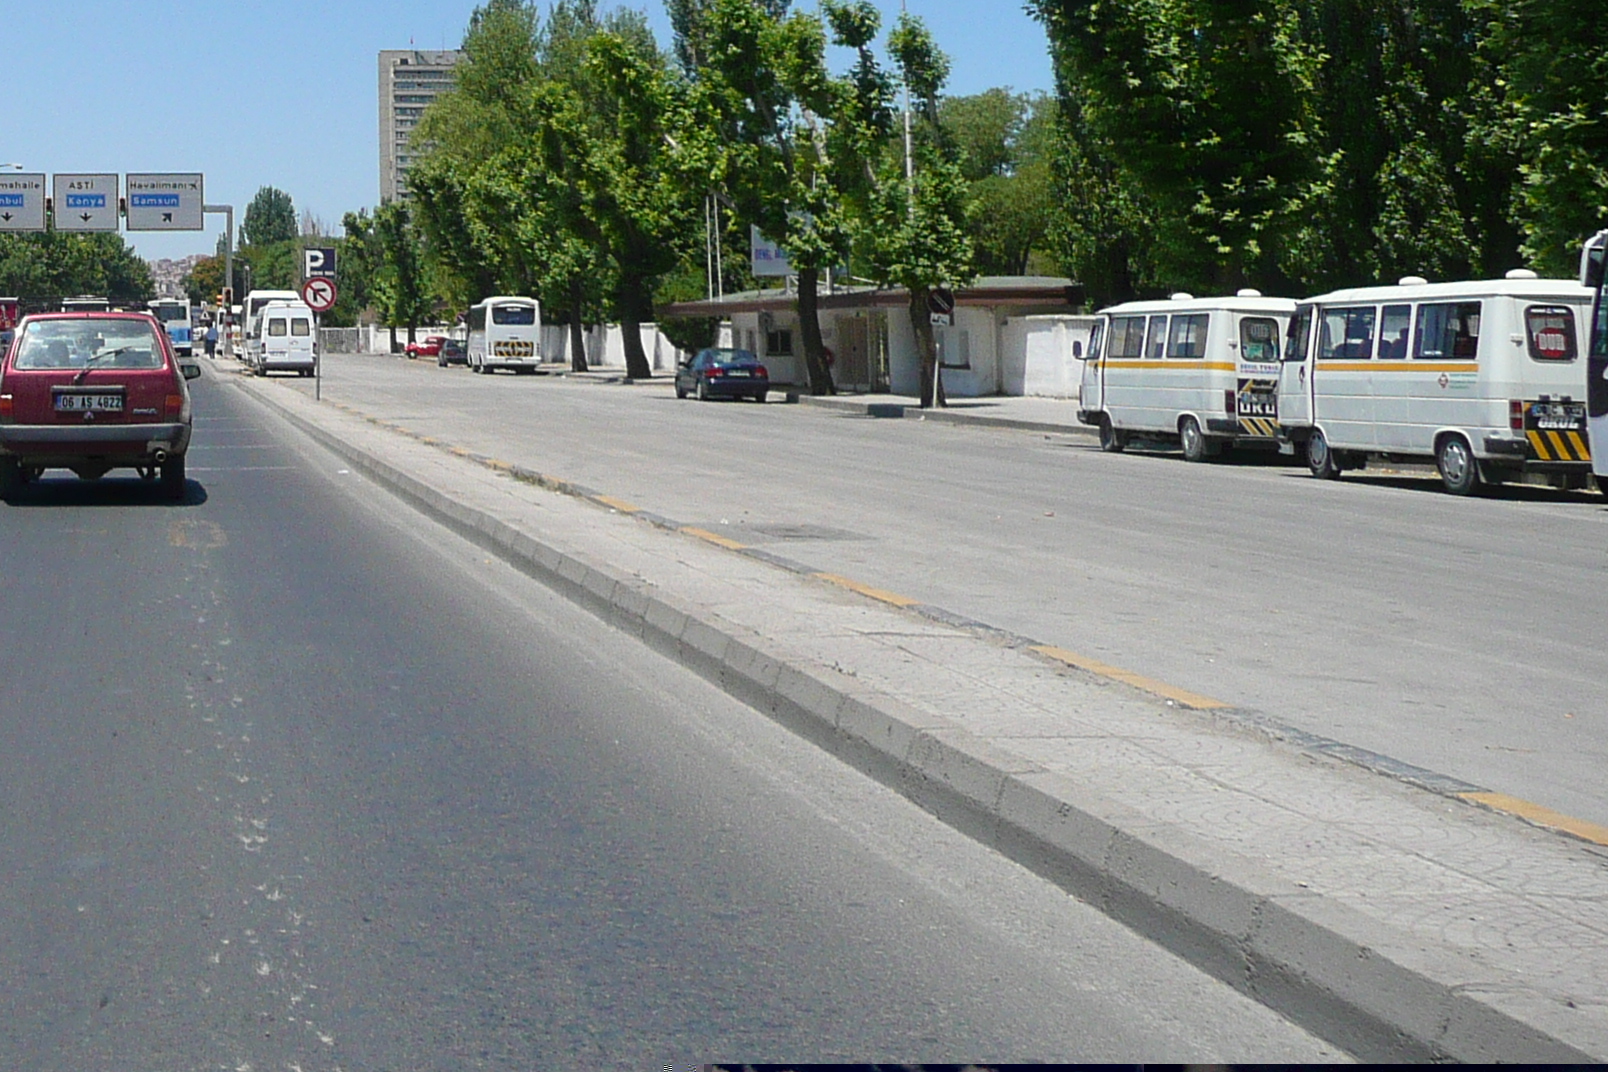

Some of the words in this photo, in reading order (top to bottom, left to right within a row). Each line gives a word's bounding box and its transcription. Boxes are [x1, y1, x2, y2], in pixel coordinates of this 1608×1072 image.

[69, 196, 104, 207] Konya
[133, 196, 178, 205] Samsun
[305, 250, 324, 278] P
[62, 396, 74, 408] 06
[81, 396, 93, 408] AS
